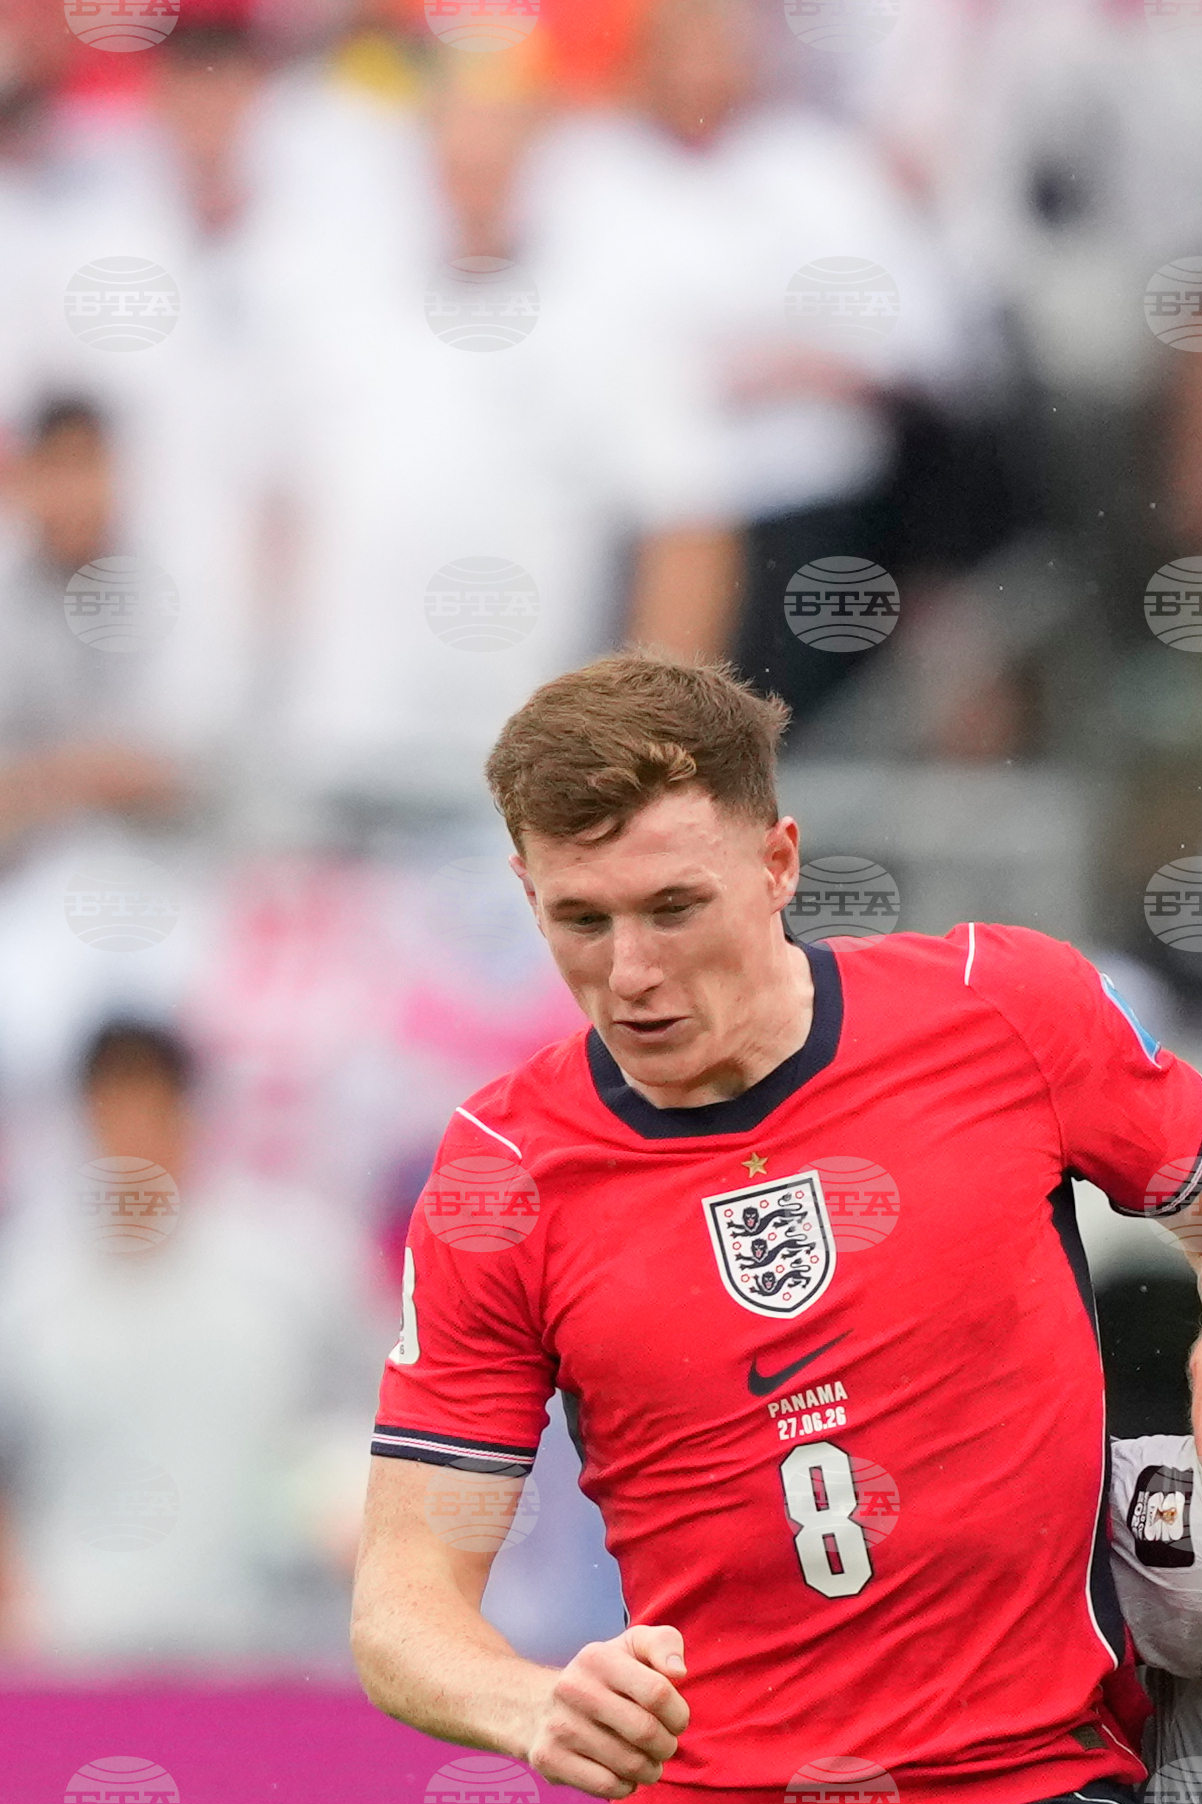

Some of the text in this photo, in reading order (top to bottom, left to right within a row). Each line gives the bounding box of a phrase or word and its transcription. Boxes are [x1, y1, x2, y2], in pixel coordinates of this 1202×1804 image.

[767, 1380, 848, 1419] PANAMA
[777, 1406, 846, 1441] 27.06.26
[779, 1440, 874, 1599] 8
